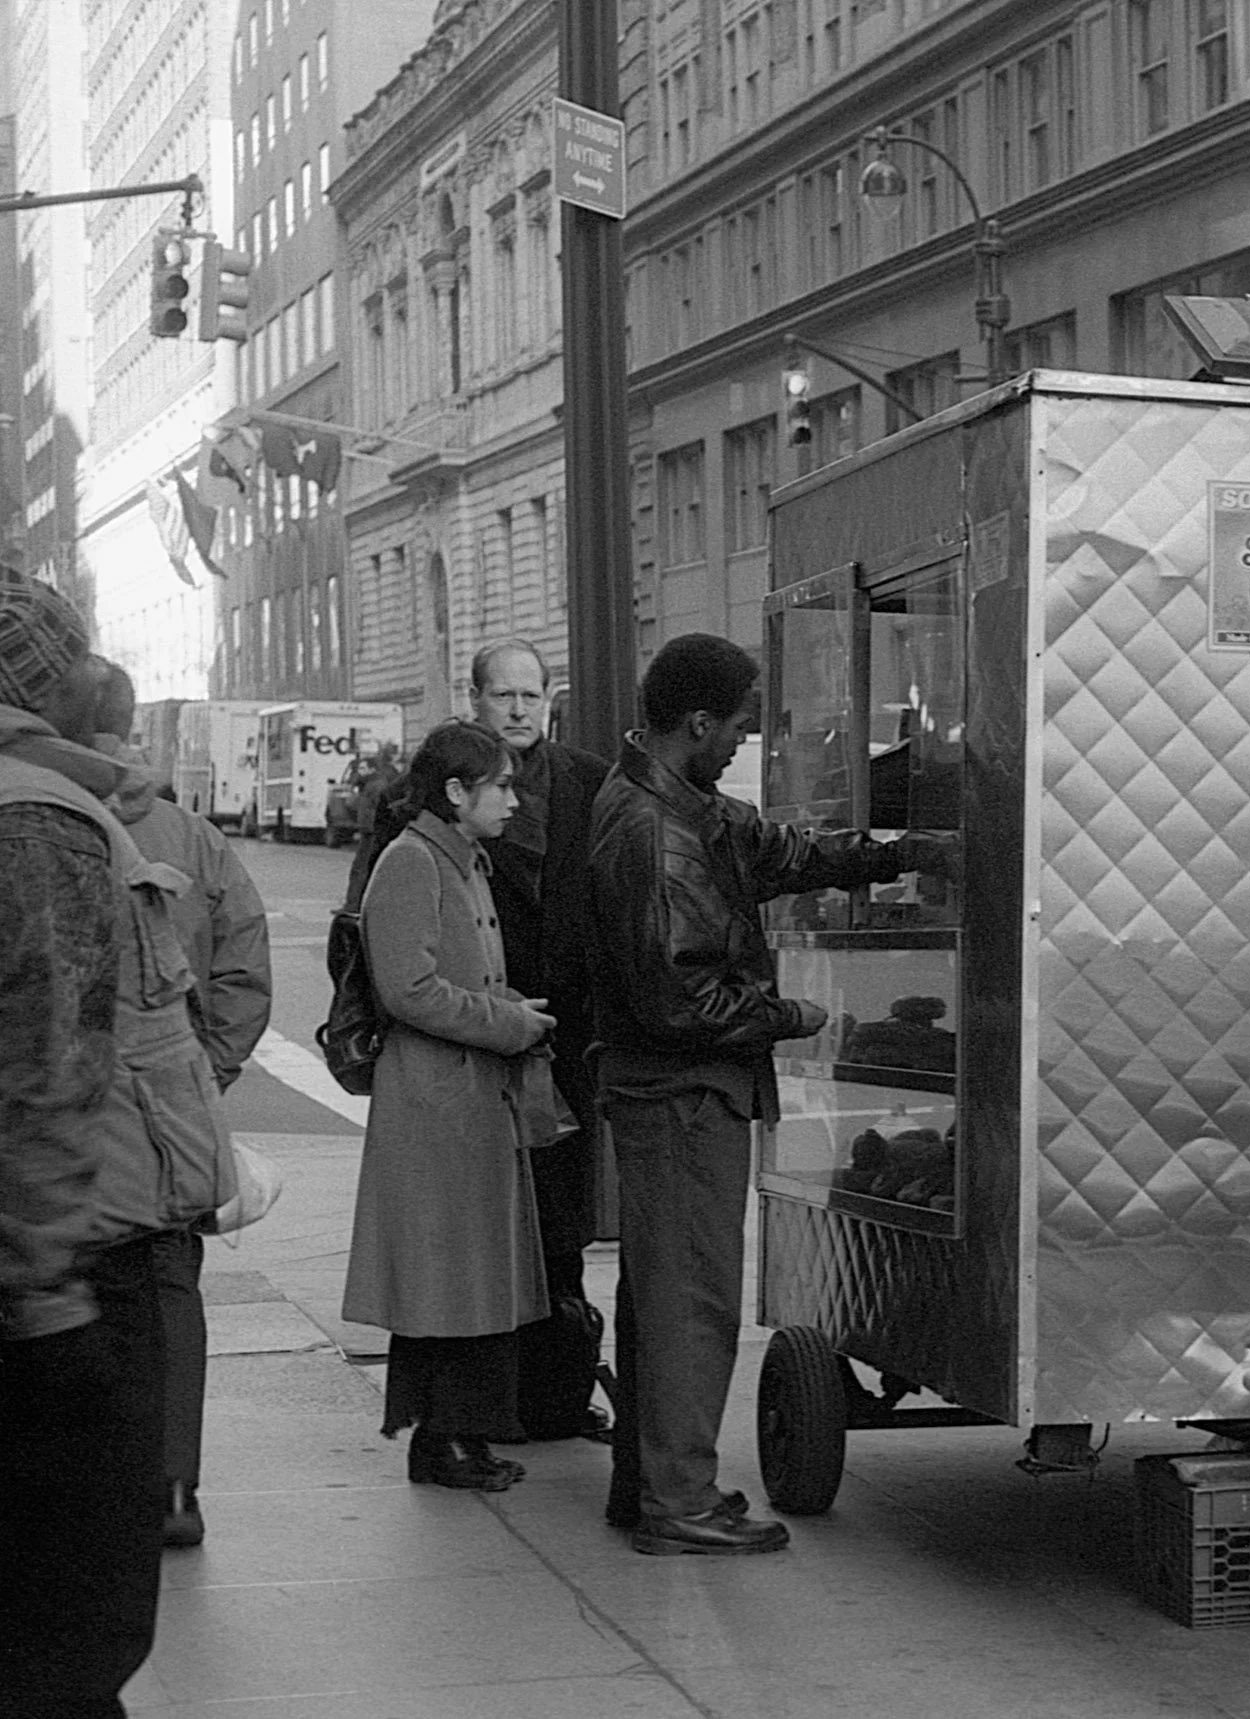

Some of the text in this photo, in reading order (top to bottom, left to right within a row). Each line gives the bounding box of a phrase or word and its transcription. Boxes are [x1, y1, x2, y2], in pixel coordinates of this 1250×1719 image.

[558, 109, 618, 149] NO STANDING
[565, 140, 612, 172] ANYTIME
